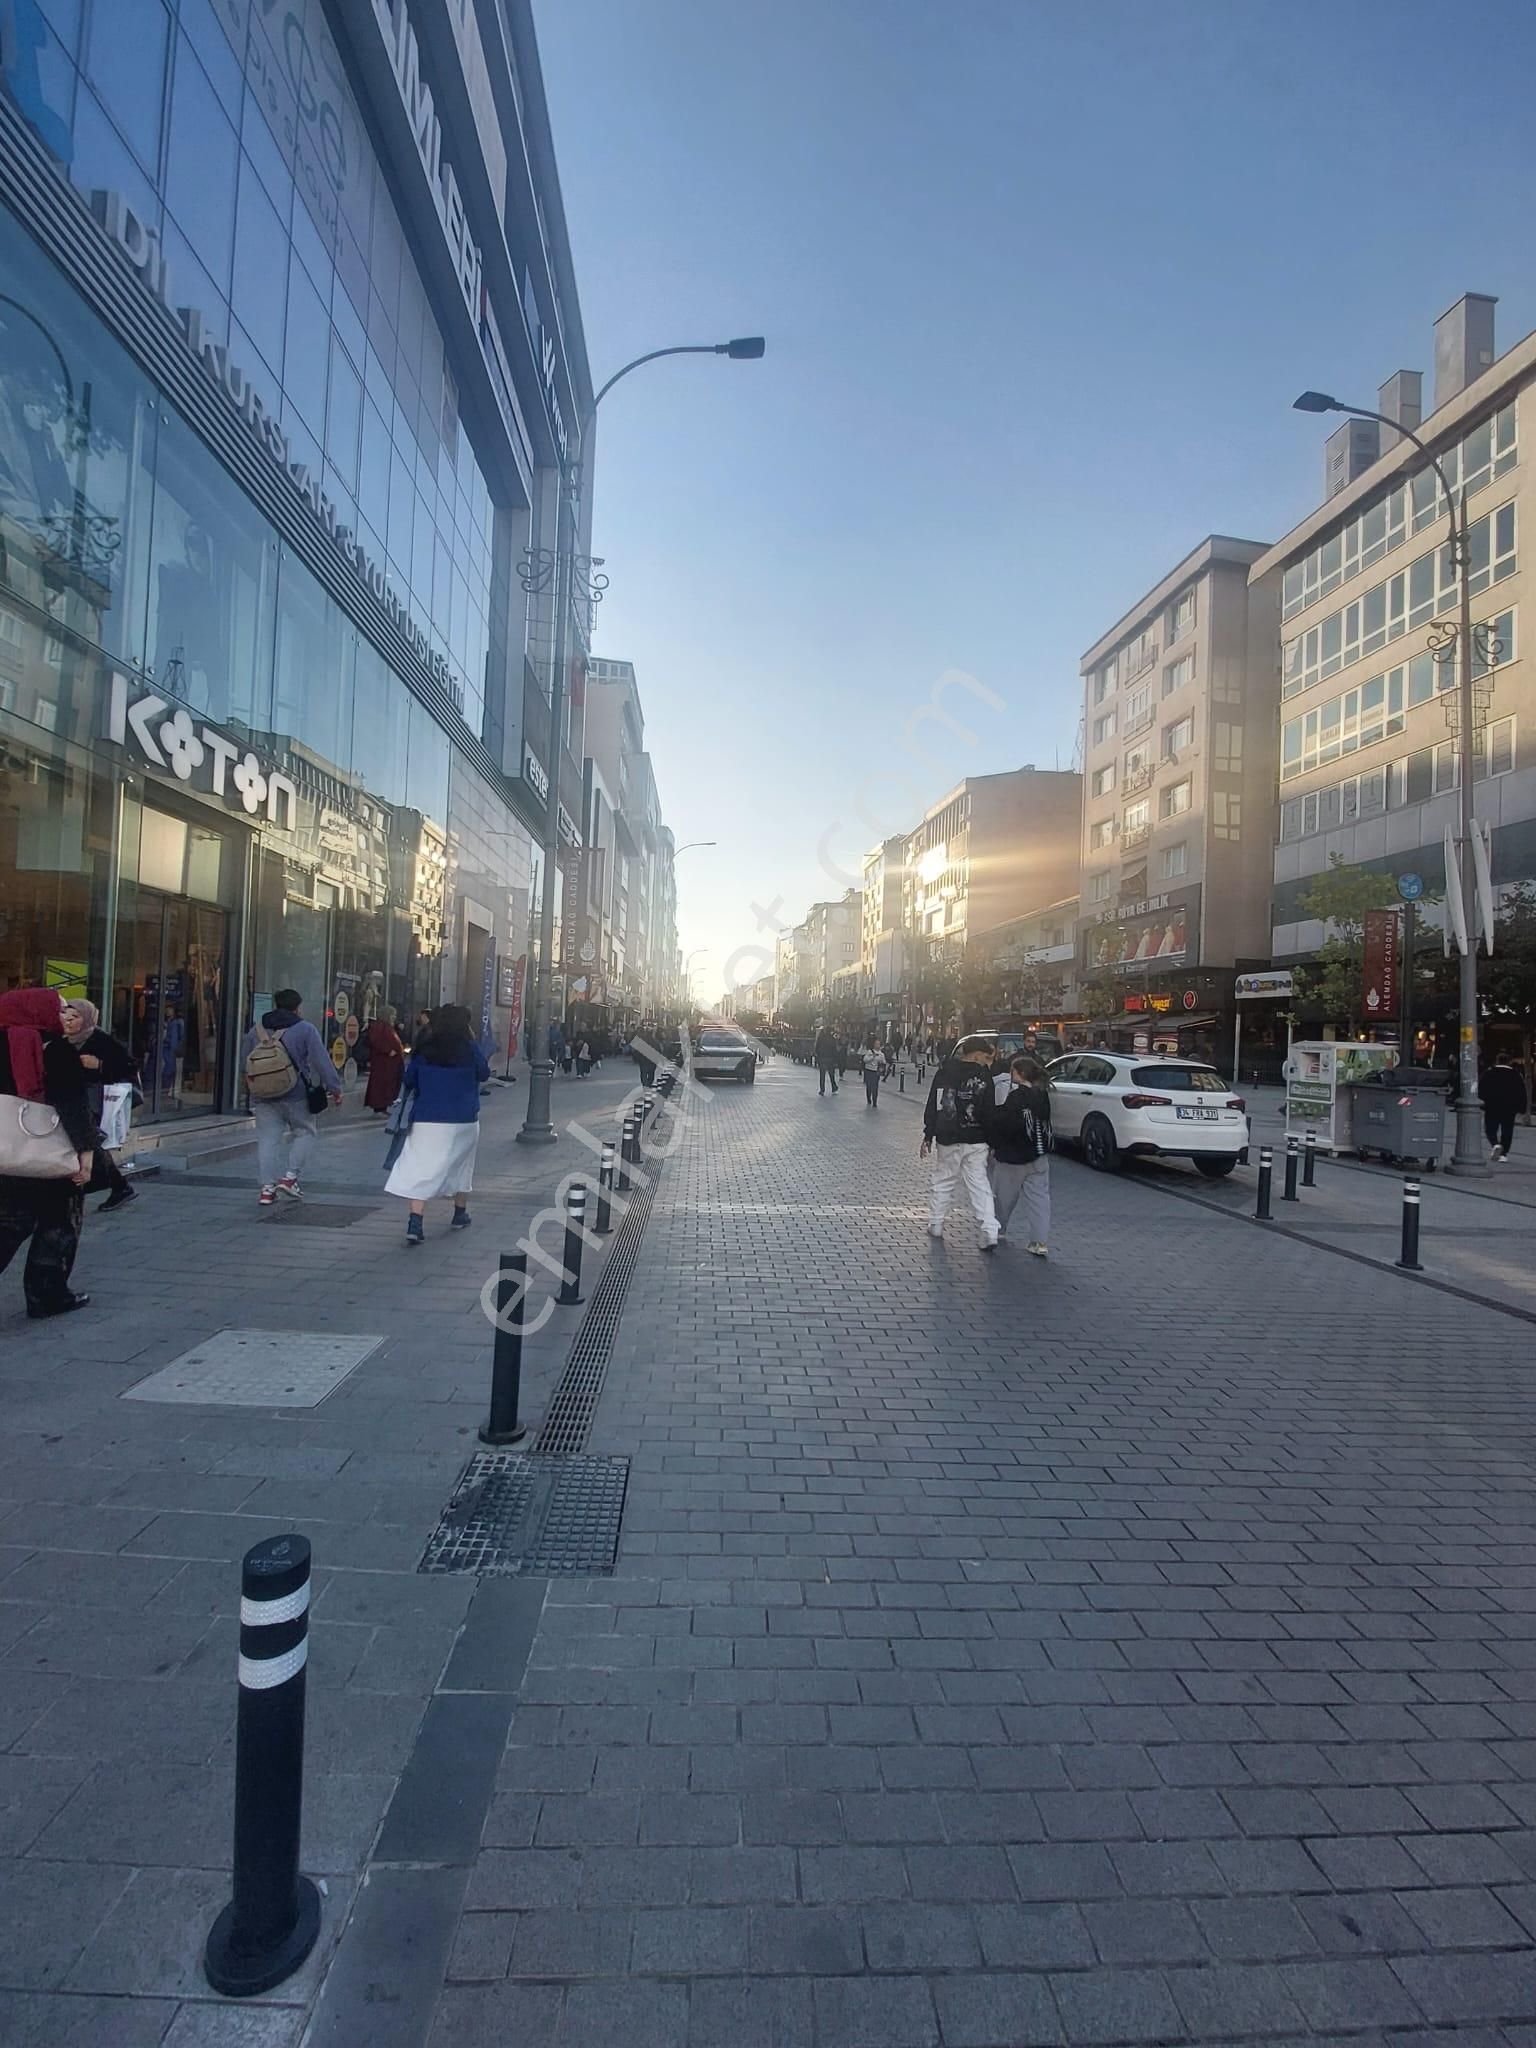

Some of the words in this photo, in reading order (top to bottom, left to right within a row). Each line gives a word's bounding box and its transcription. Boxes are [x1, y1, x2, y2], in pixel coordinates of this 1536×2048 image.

[196, 310, 338, 539] KURSLARI
[365, 555, 403, 625] YURT
[110, 672, 297, 832] KOTON
